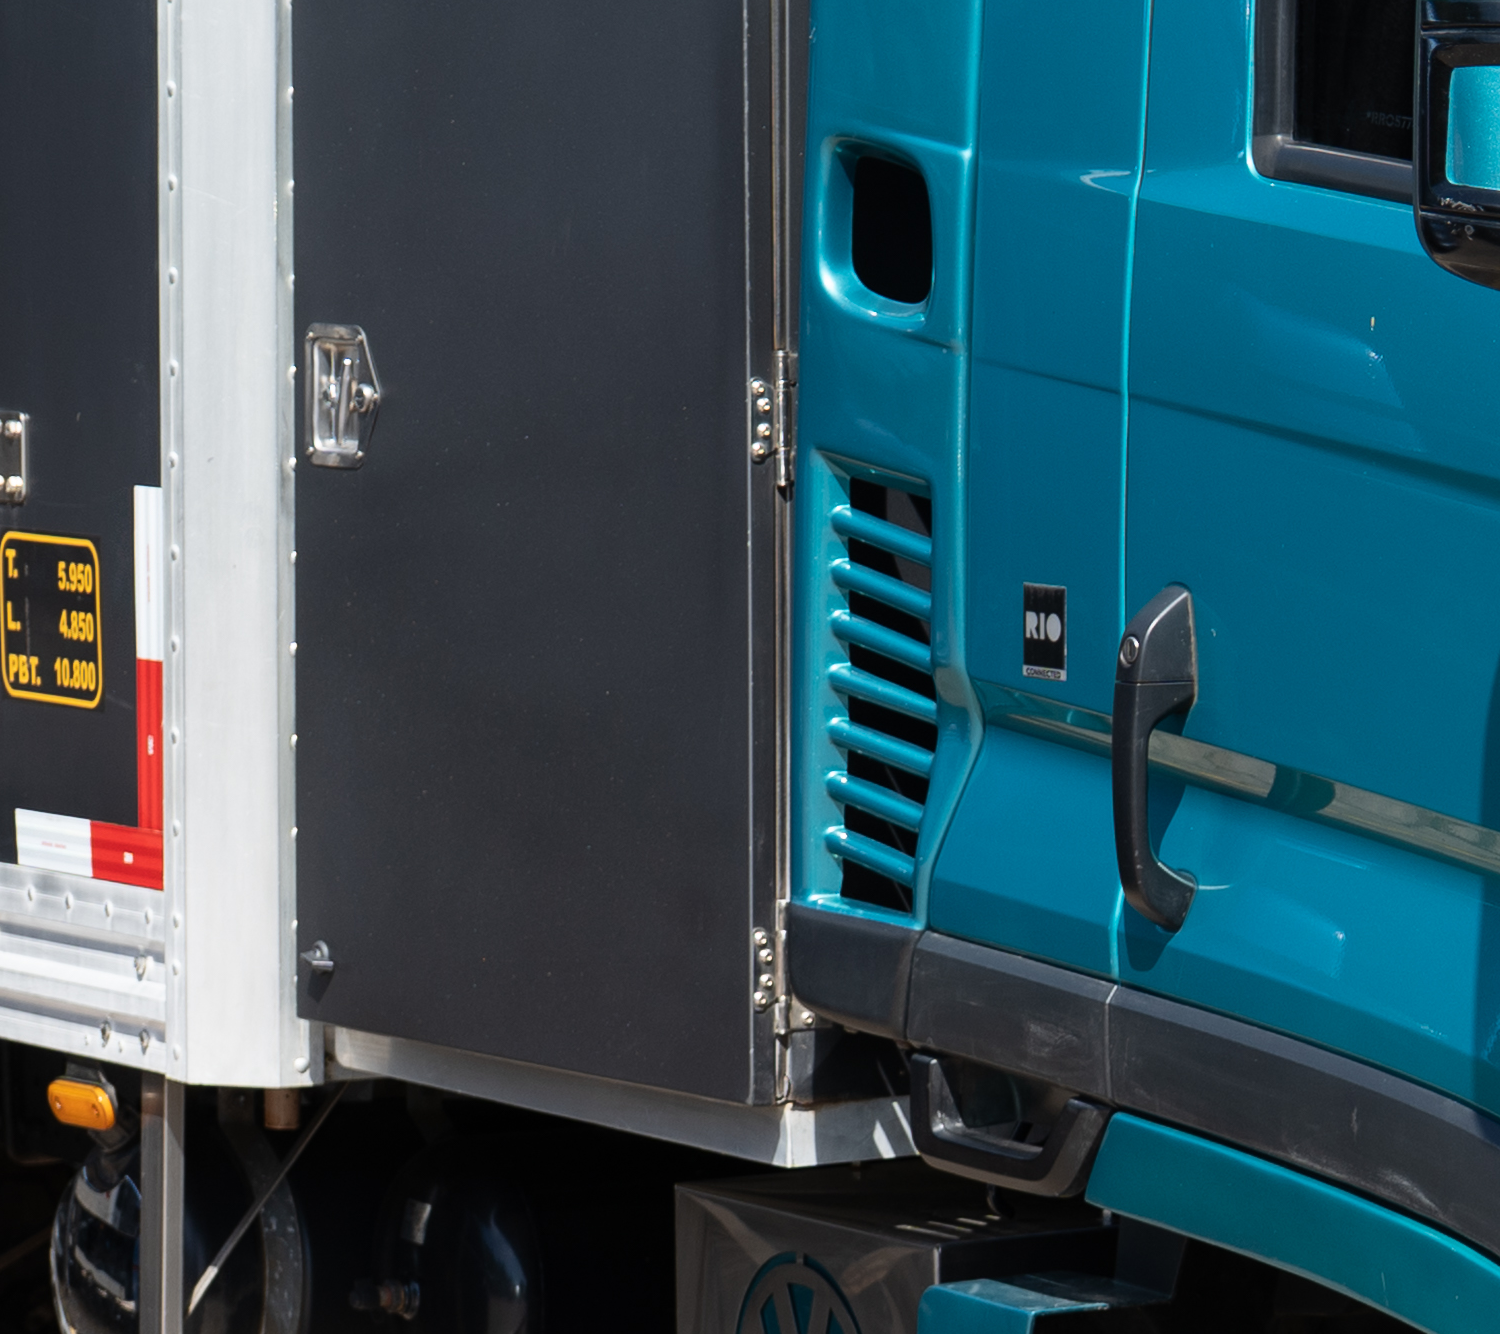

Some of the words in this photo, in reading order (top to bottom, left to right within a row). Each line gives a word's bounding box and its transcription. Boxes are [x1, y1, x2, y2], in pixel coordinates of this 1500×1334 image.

[5, 548, 19, 578] T.
[57, 560, 93, 594] 5.950
[6, 600, 22, 631] L.
[59, 609, 94, 643] 4.850
[1025, 611, 1062, 643] RIO
[8, 653, 42, 687] PBT.
[54, 656, 96, 691] 10.800
[1025, 667, 1062, 680] CONNECTED
